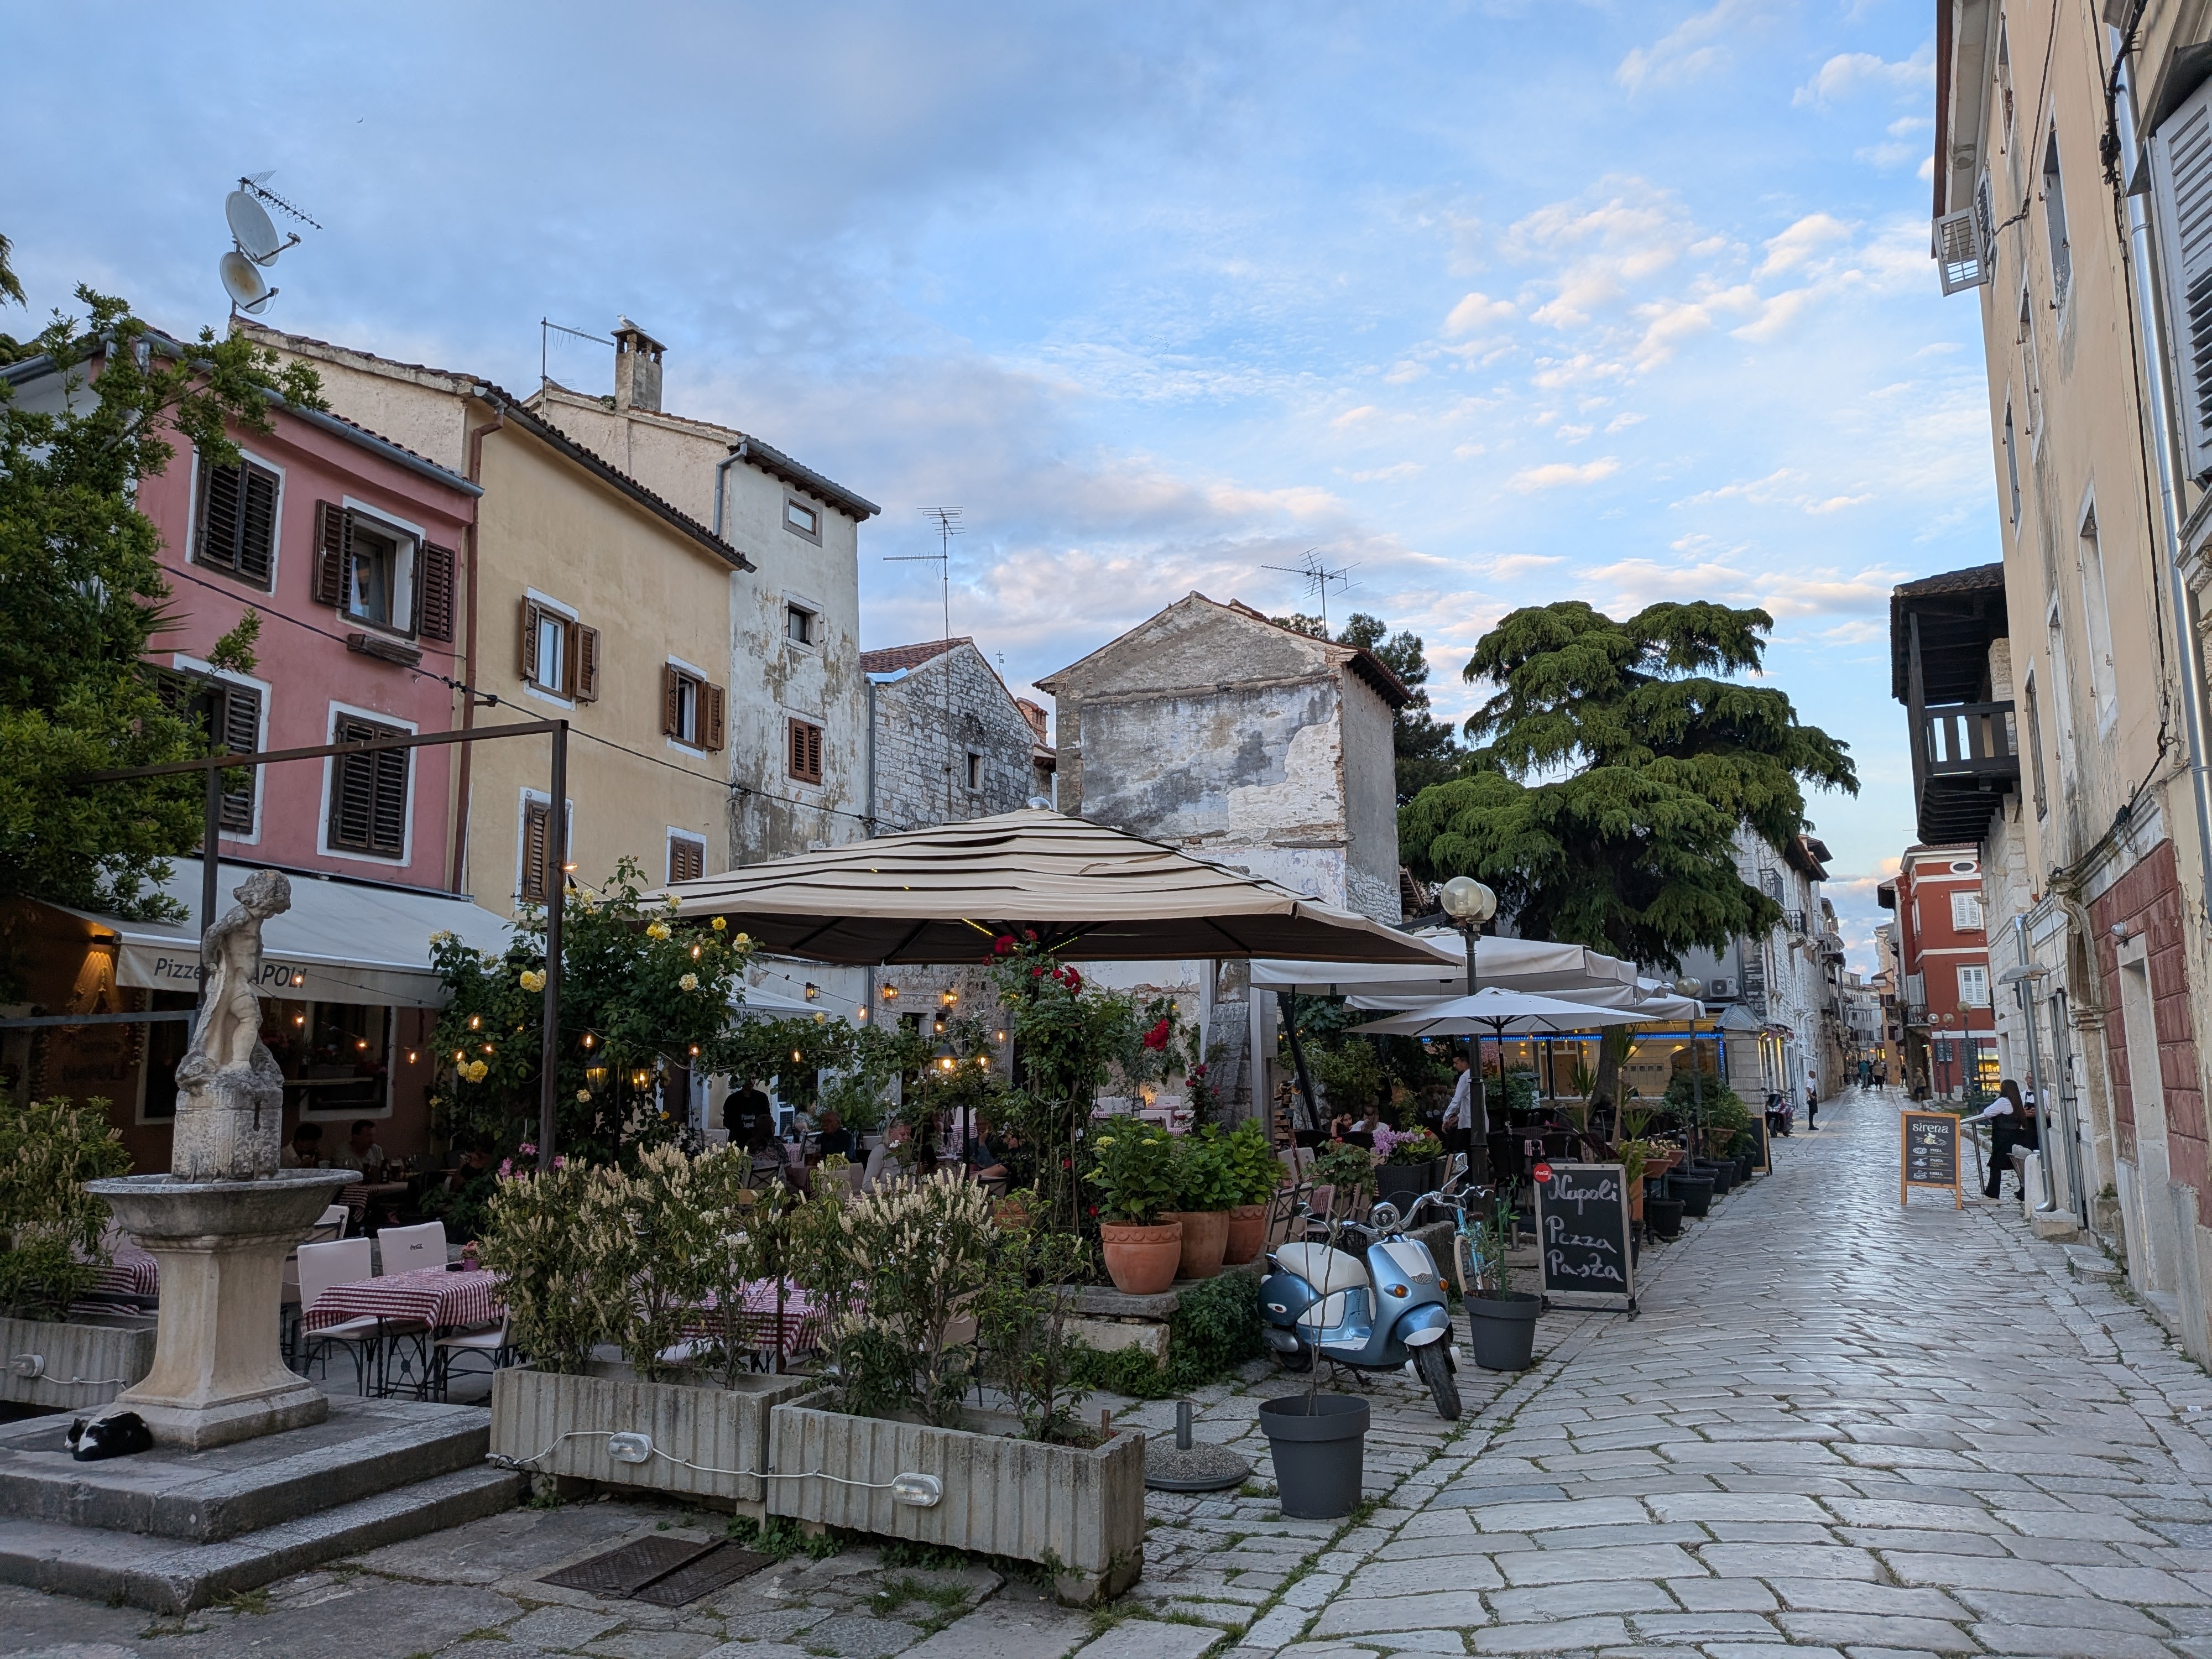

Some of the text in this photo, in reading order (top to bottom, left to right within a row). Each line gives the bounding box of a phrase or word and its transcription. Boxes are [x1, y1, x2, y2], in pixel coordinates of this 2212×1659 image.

[154, 957, 307, 989] Pizze APOLI
[1912, 1122, 1949, 1134] sirena
[1548, 1173, 1619, 1215] Napoli
[1545, 1215, 1618, 1254] Pizza
[1547, 1249, 1624, 1282] Pasta
